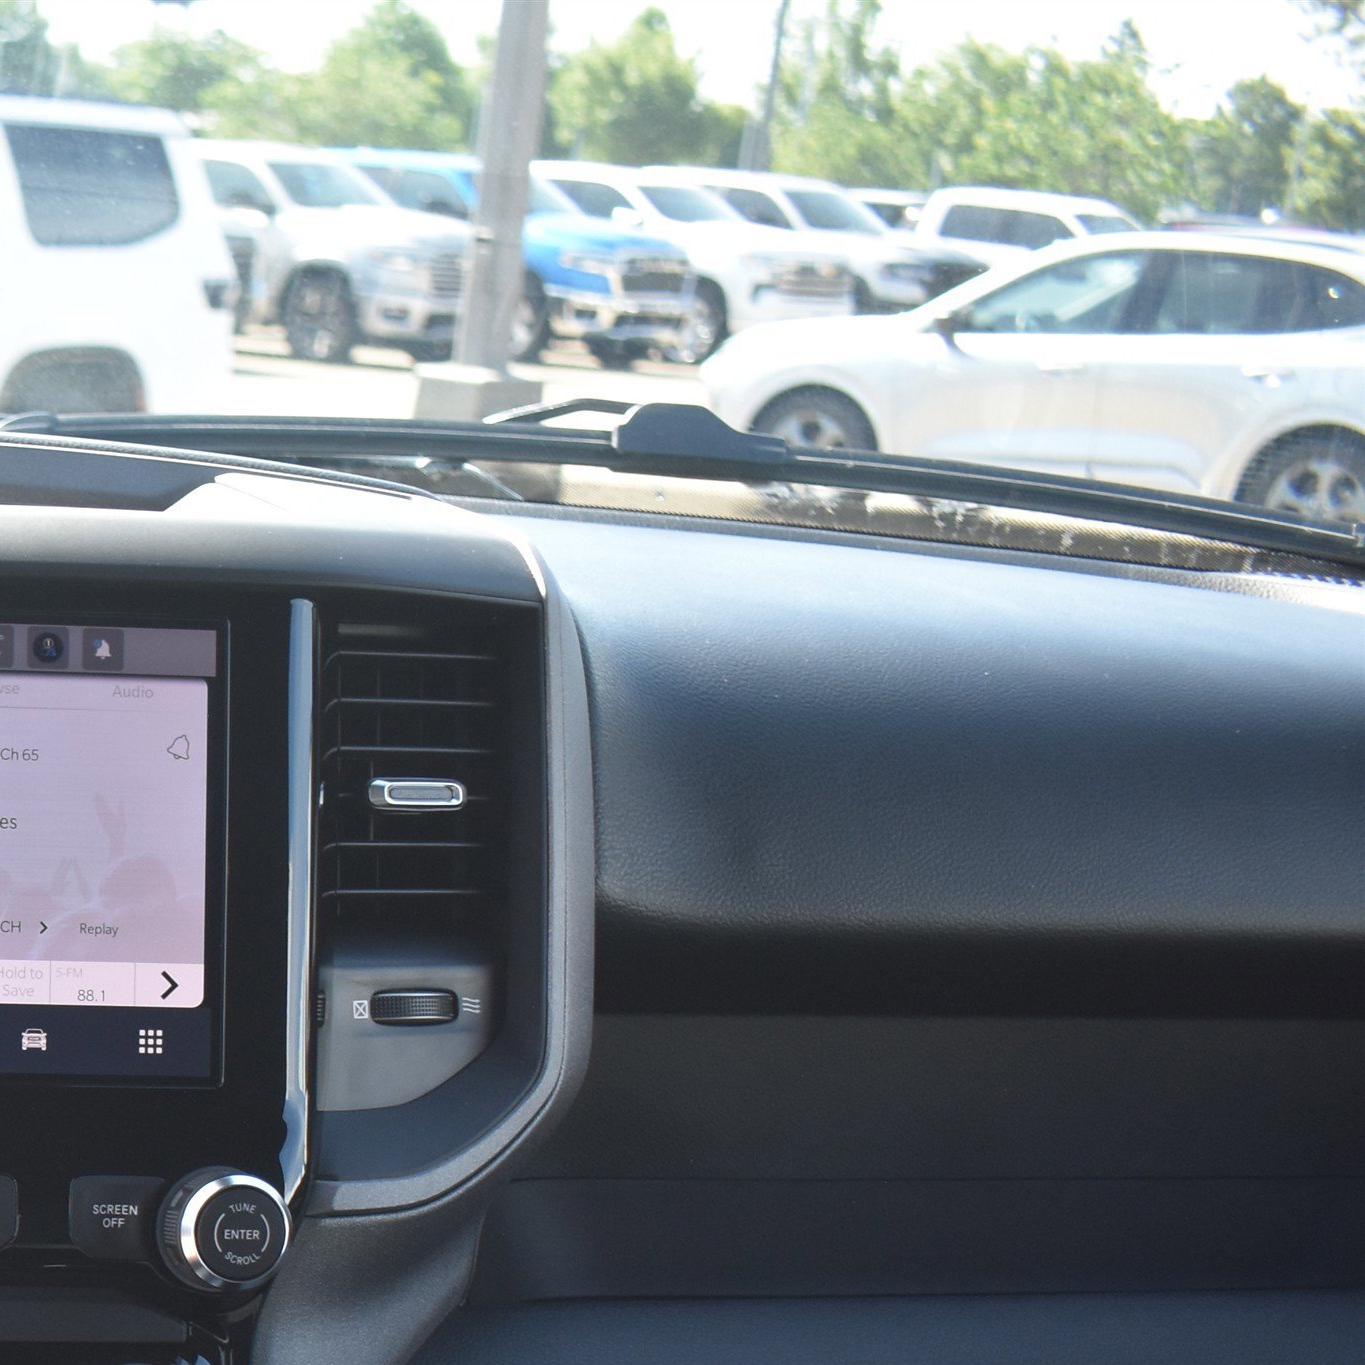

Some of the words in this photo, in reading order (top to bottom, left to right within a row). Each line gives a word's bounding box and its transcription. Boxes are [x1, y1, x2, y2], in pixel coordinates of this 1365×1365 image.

[112, 685, 154, 699] Audio
[0, 749, 19, 761] Ch
[22, 749, 39, 761] 65
[0, 921, 22, 933] CH
[79, 923, 119, 938] Replay
[29, 968, 43, 979] to
[2, 985, 35, 997] Save
[77, 989, 106, 1002] 88.1
[92, 1204, 138, 1216] SCREEN
[228, 1203, 257, 1215] TUNE
[102, 1217, 126, 1229] OFF
[224, 1229, 260, 1240] ENTER
[224, 1251, 261, 1266] SCROLL
